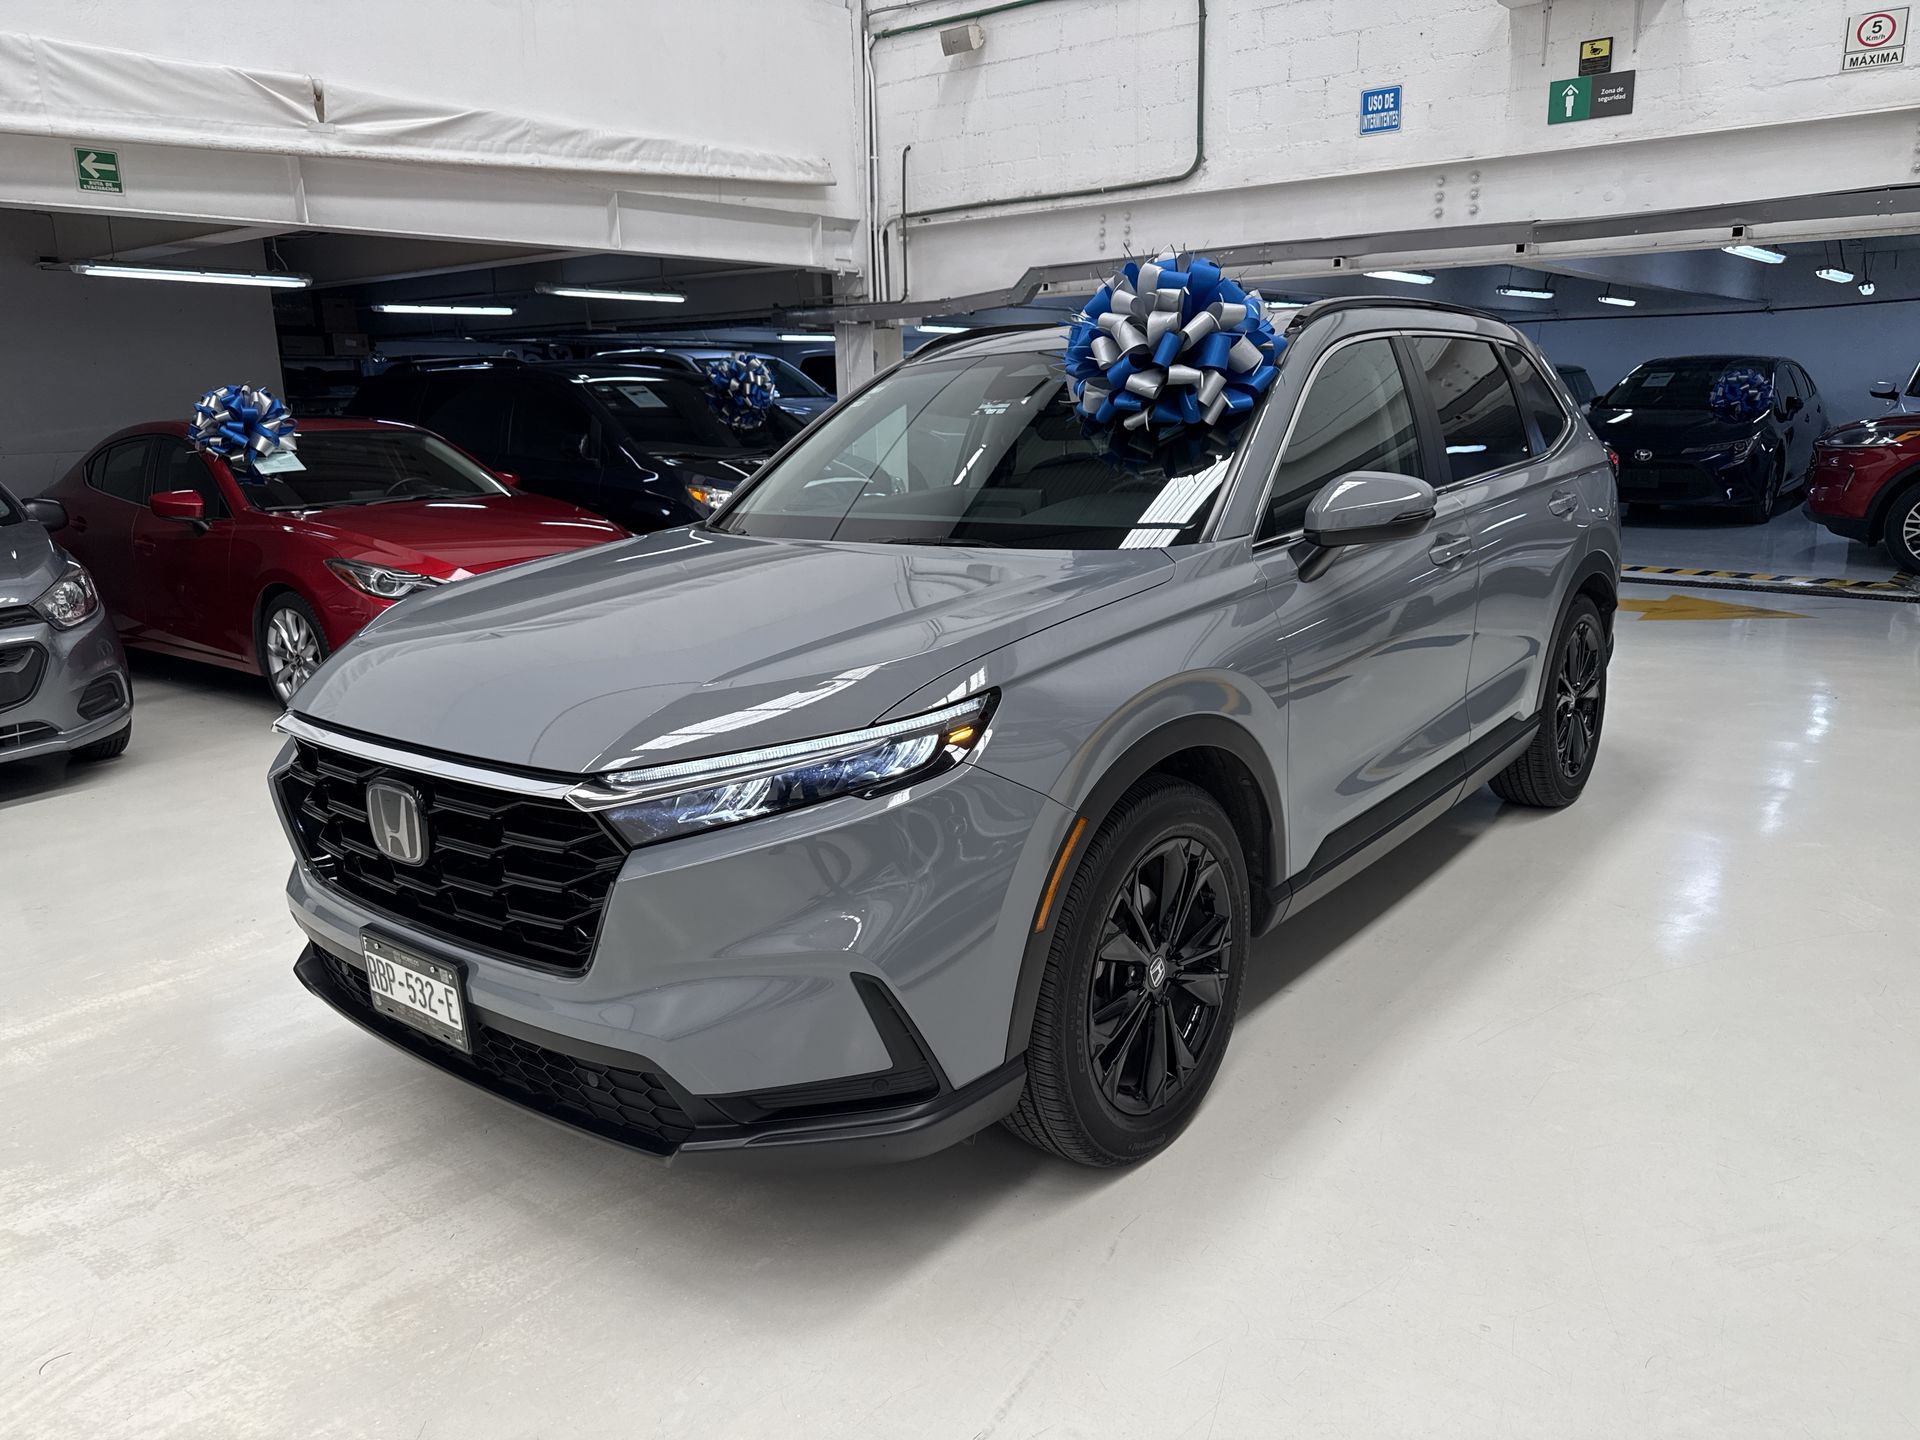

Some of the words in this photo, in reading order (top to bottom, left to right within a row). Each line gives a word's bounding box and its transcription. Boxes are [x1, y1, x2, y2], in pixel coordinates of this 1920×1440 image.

[1871, 20, 1883, 34] 5
[1848, 52, 1899, 67] MÁXIMA
[1367, 94, 1383, 112] USO
[1384, 92, 1395, 109] DE
[1598, 93, 1626, 103] seguridad
[366, 954, 460, 1025] RBP-532-E
